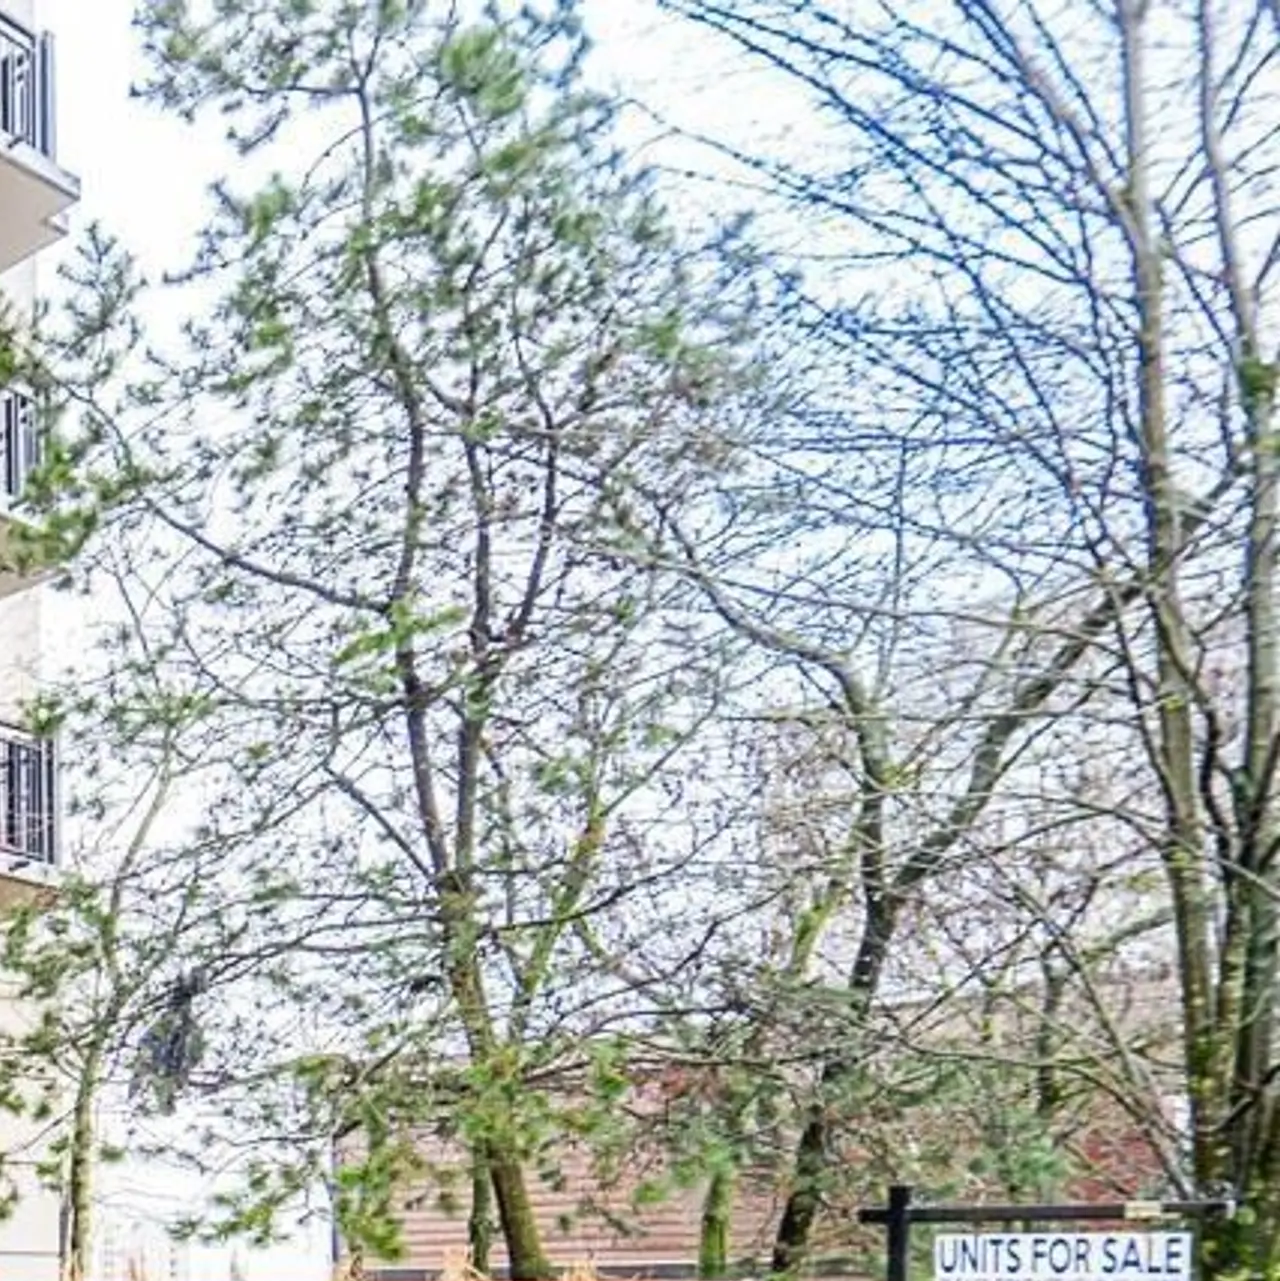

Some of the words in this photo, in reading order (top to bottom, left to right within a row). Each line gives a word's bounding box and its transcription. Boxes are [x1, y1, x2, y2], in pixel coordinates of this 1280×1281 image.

[941, 1238, 1021, 1273] UNITS
[1032, 1237, 1091, 1273] FOR
[1101, 1237, 1183, 1273] SALE
